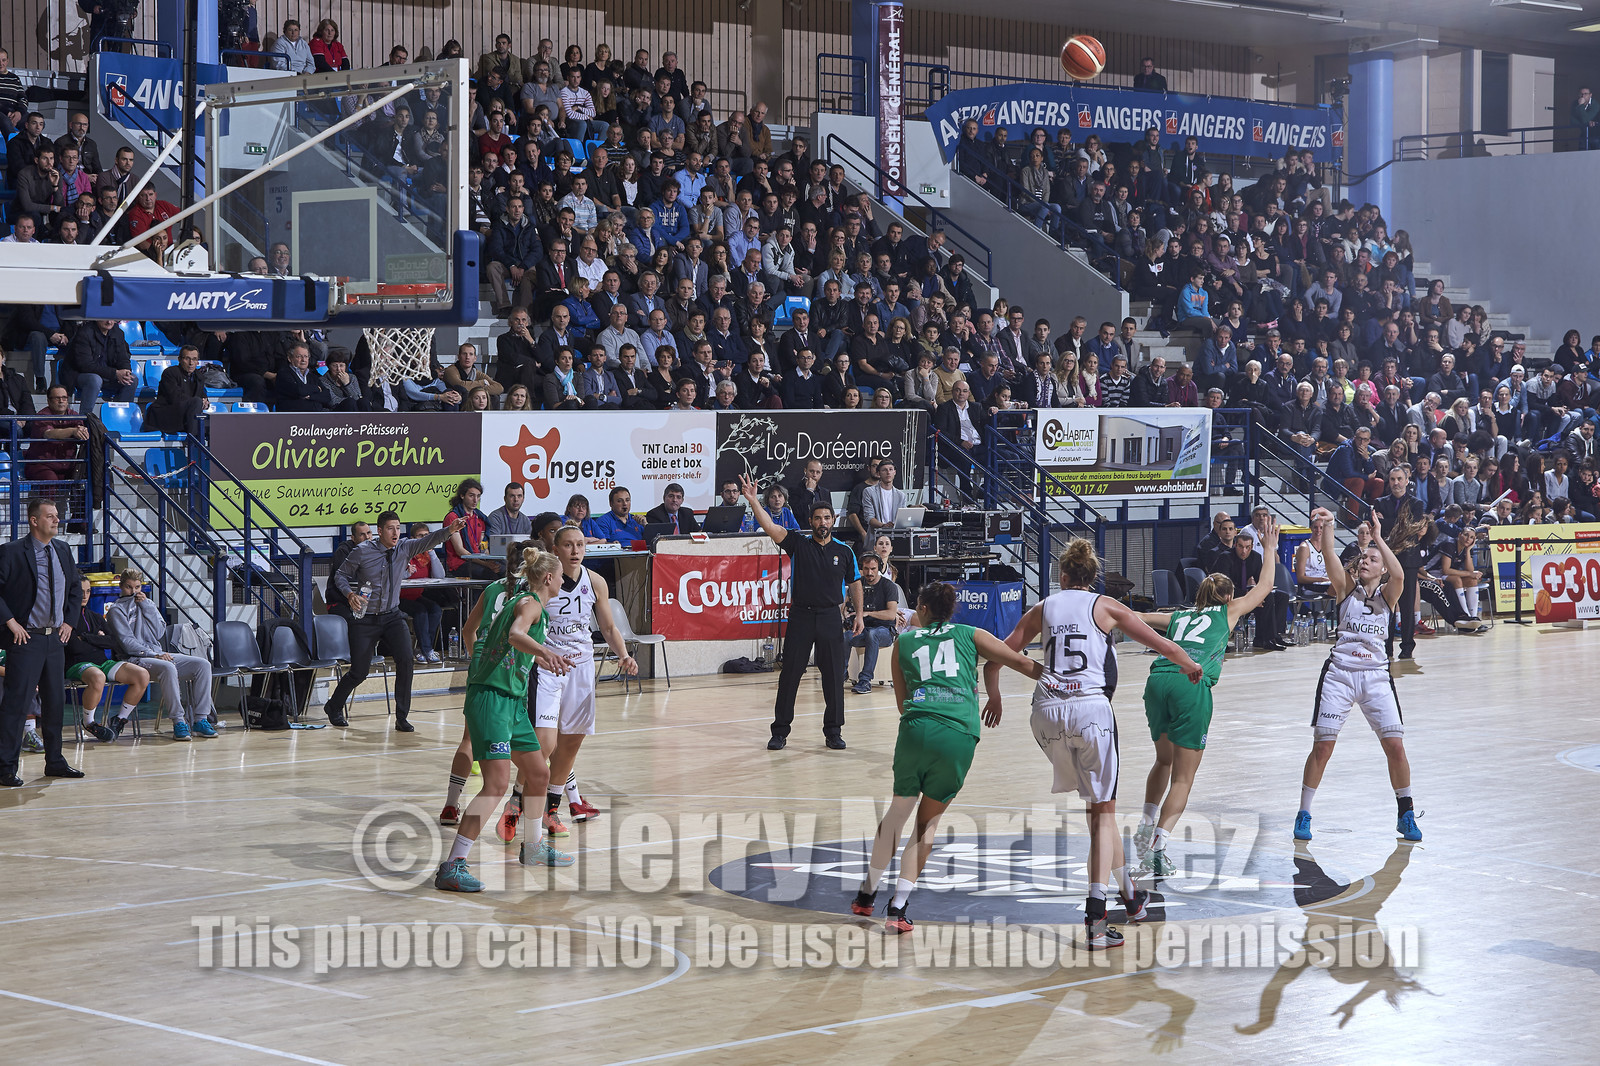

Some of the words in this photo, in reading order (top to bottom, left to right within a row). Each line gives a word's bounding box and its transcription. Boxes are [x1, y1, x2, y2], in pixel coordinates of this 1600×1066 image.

[885, 27, 900, 108] GÉNÉRAL
[996, 100, 1070, 126] ANGERS
[1093, 105, 1162, 132] ANGERS
[1178, 112, 1246, 140] ANGERS
[1264, 121, 1326, 148] ANGERS
[887, 114, 900, 192] CONSEIL
[167, 291, 237, 310] MARTY
[290, 423, 410, 440] Boulangerie-Pâtisserie
[252, 437, 346, 470] Olivier
[356, 436, 444, 468] Pothin
[642, 443, 661, 455] TNT
[663, 442, 688, 454] Canal
[690, 442, 703, 454] 30
[766, 433, 787, 461] La
[796, 432, 892, 460] Doréenne
[522, 445, 615, 483] angers
[641, 457, 668, 470] câble
[670, 457, 681, 469] et
[683, 456, 702, 469] box
[836, 461, 865, 472] Boulanger
[593, 477, 615, 491] télé
[1080, 472, 1088, 480] de
[1113, 472, 1125, 480] bois
[1139, 471, 1162, 480] budgets
[277, 482, 354, 500] Saumuroise
[373, 482, 421, 496] 49000
[425, 481, 458, 499] Ange
[1084, 484, 1095, 496] 17
[1096, 483, 1110, 496] 47
[1134, 481, 1204, 494] www.sohabitat.fr
[289, 504, 310, 517] 02
[315, 502, 335, 516] 41
[340, 501, 359, 515] 66
[364, 500, 384, 514] 35
[388, 501, 407, 515] 07
[1496, 537, 1543, 553] SUER
[558, 595, 582, 615] 21
[659, 588, 675, 605] Le
[739, 607, 754, 621] de
[756, 606, 790, 621] l'ouest
[1362, 598, 1374, 616] 5
[1048, 624, 1081, 634] TURMEL
[1172, 614, 1212, 644] 12
[1346, 622, 1385, 635] ANGERS
[911, 638, 960, 681] 14
[1045, 634, 1088, 675] 15
[1351, 650, 1372, 659] Géant
